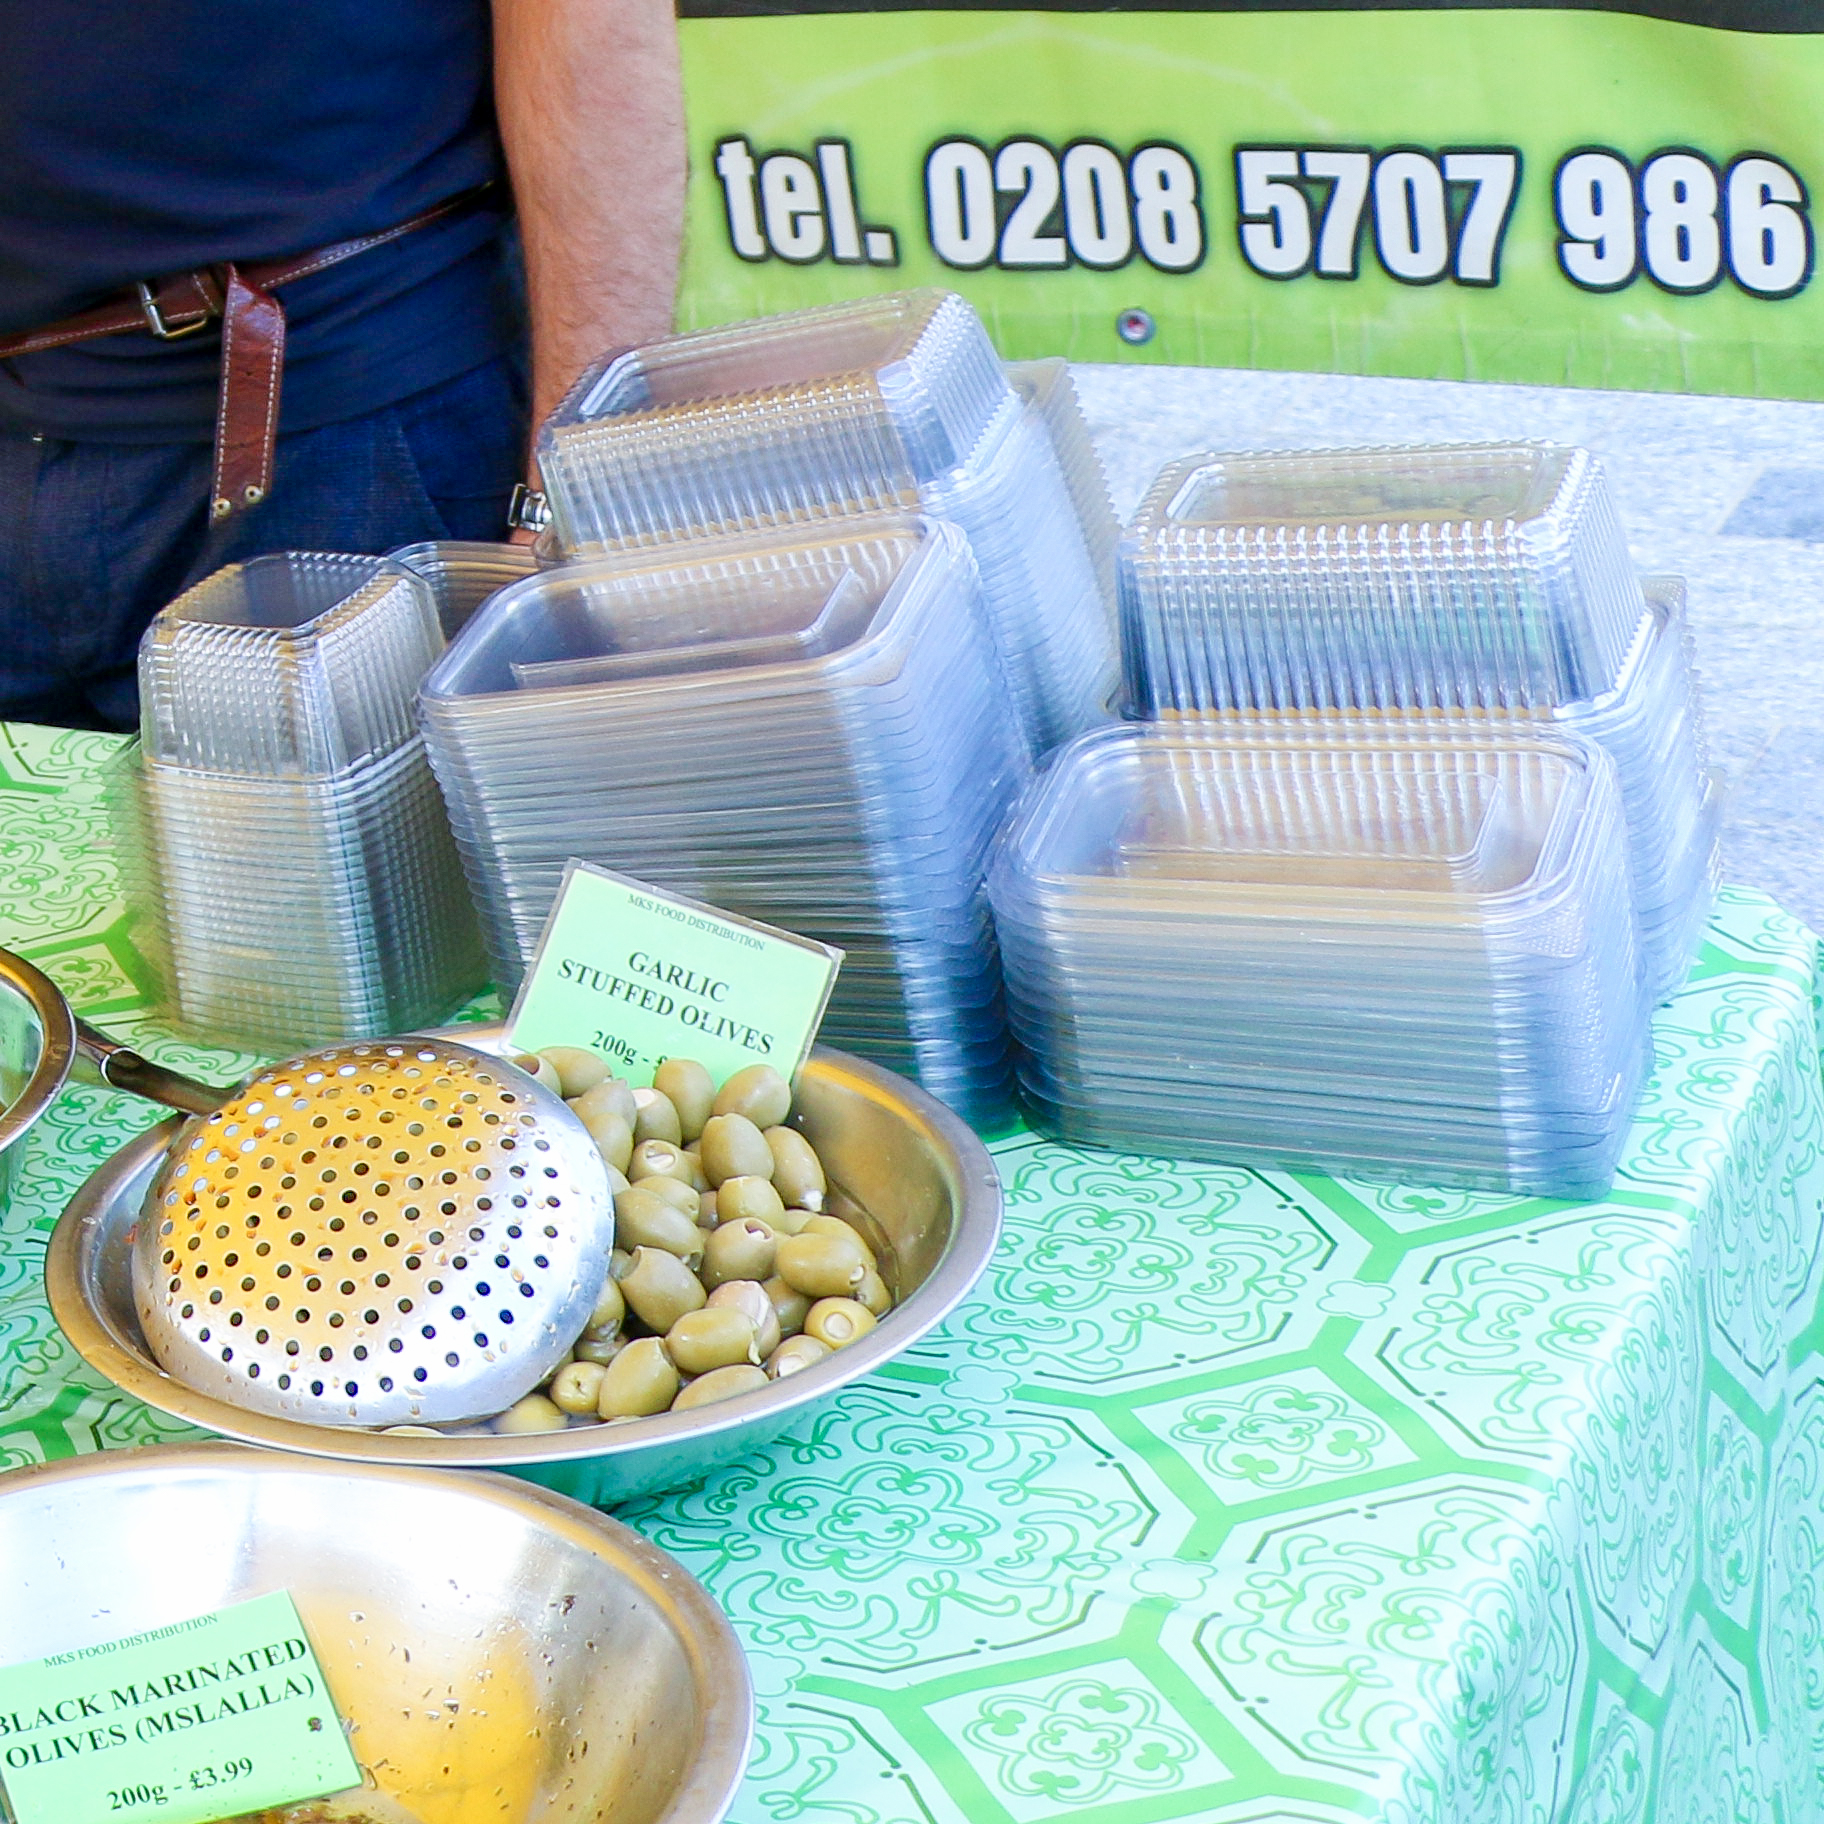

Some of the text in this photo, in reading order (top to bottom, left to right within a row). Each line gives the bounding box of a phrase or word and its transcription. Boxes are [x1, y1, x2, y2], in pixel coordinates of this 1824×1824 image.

[714, 132, 1815, 300] tel. 0208 5707 986
[628, 893, 766, 952] MKS FOOD DISTRIBUTION
[628, 950, 730, 1004] GARLIC
[557, 958, 775, 1056] STUFFED OLIVES
[590, 1029, 639, 1067] 200g
[43, 1613, 219, 1669] MKS FOOD DISTRIBUTION
[109, 1637, 307, 1711] MARINATED
[4, 1672, 316, 1770] OLIVES (MSLALLA)
[107, 1783, 169, 1811] 200g
[188, 1756, 254, 1790] £3.99
